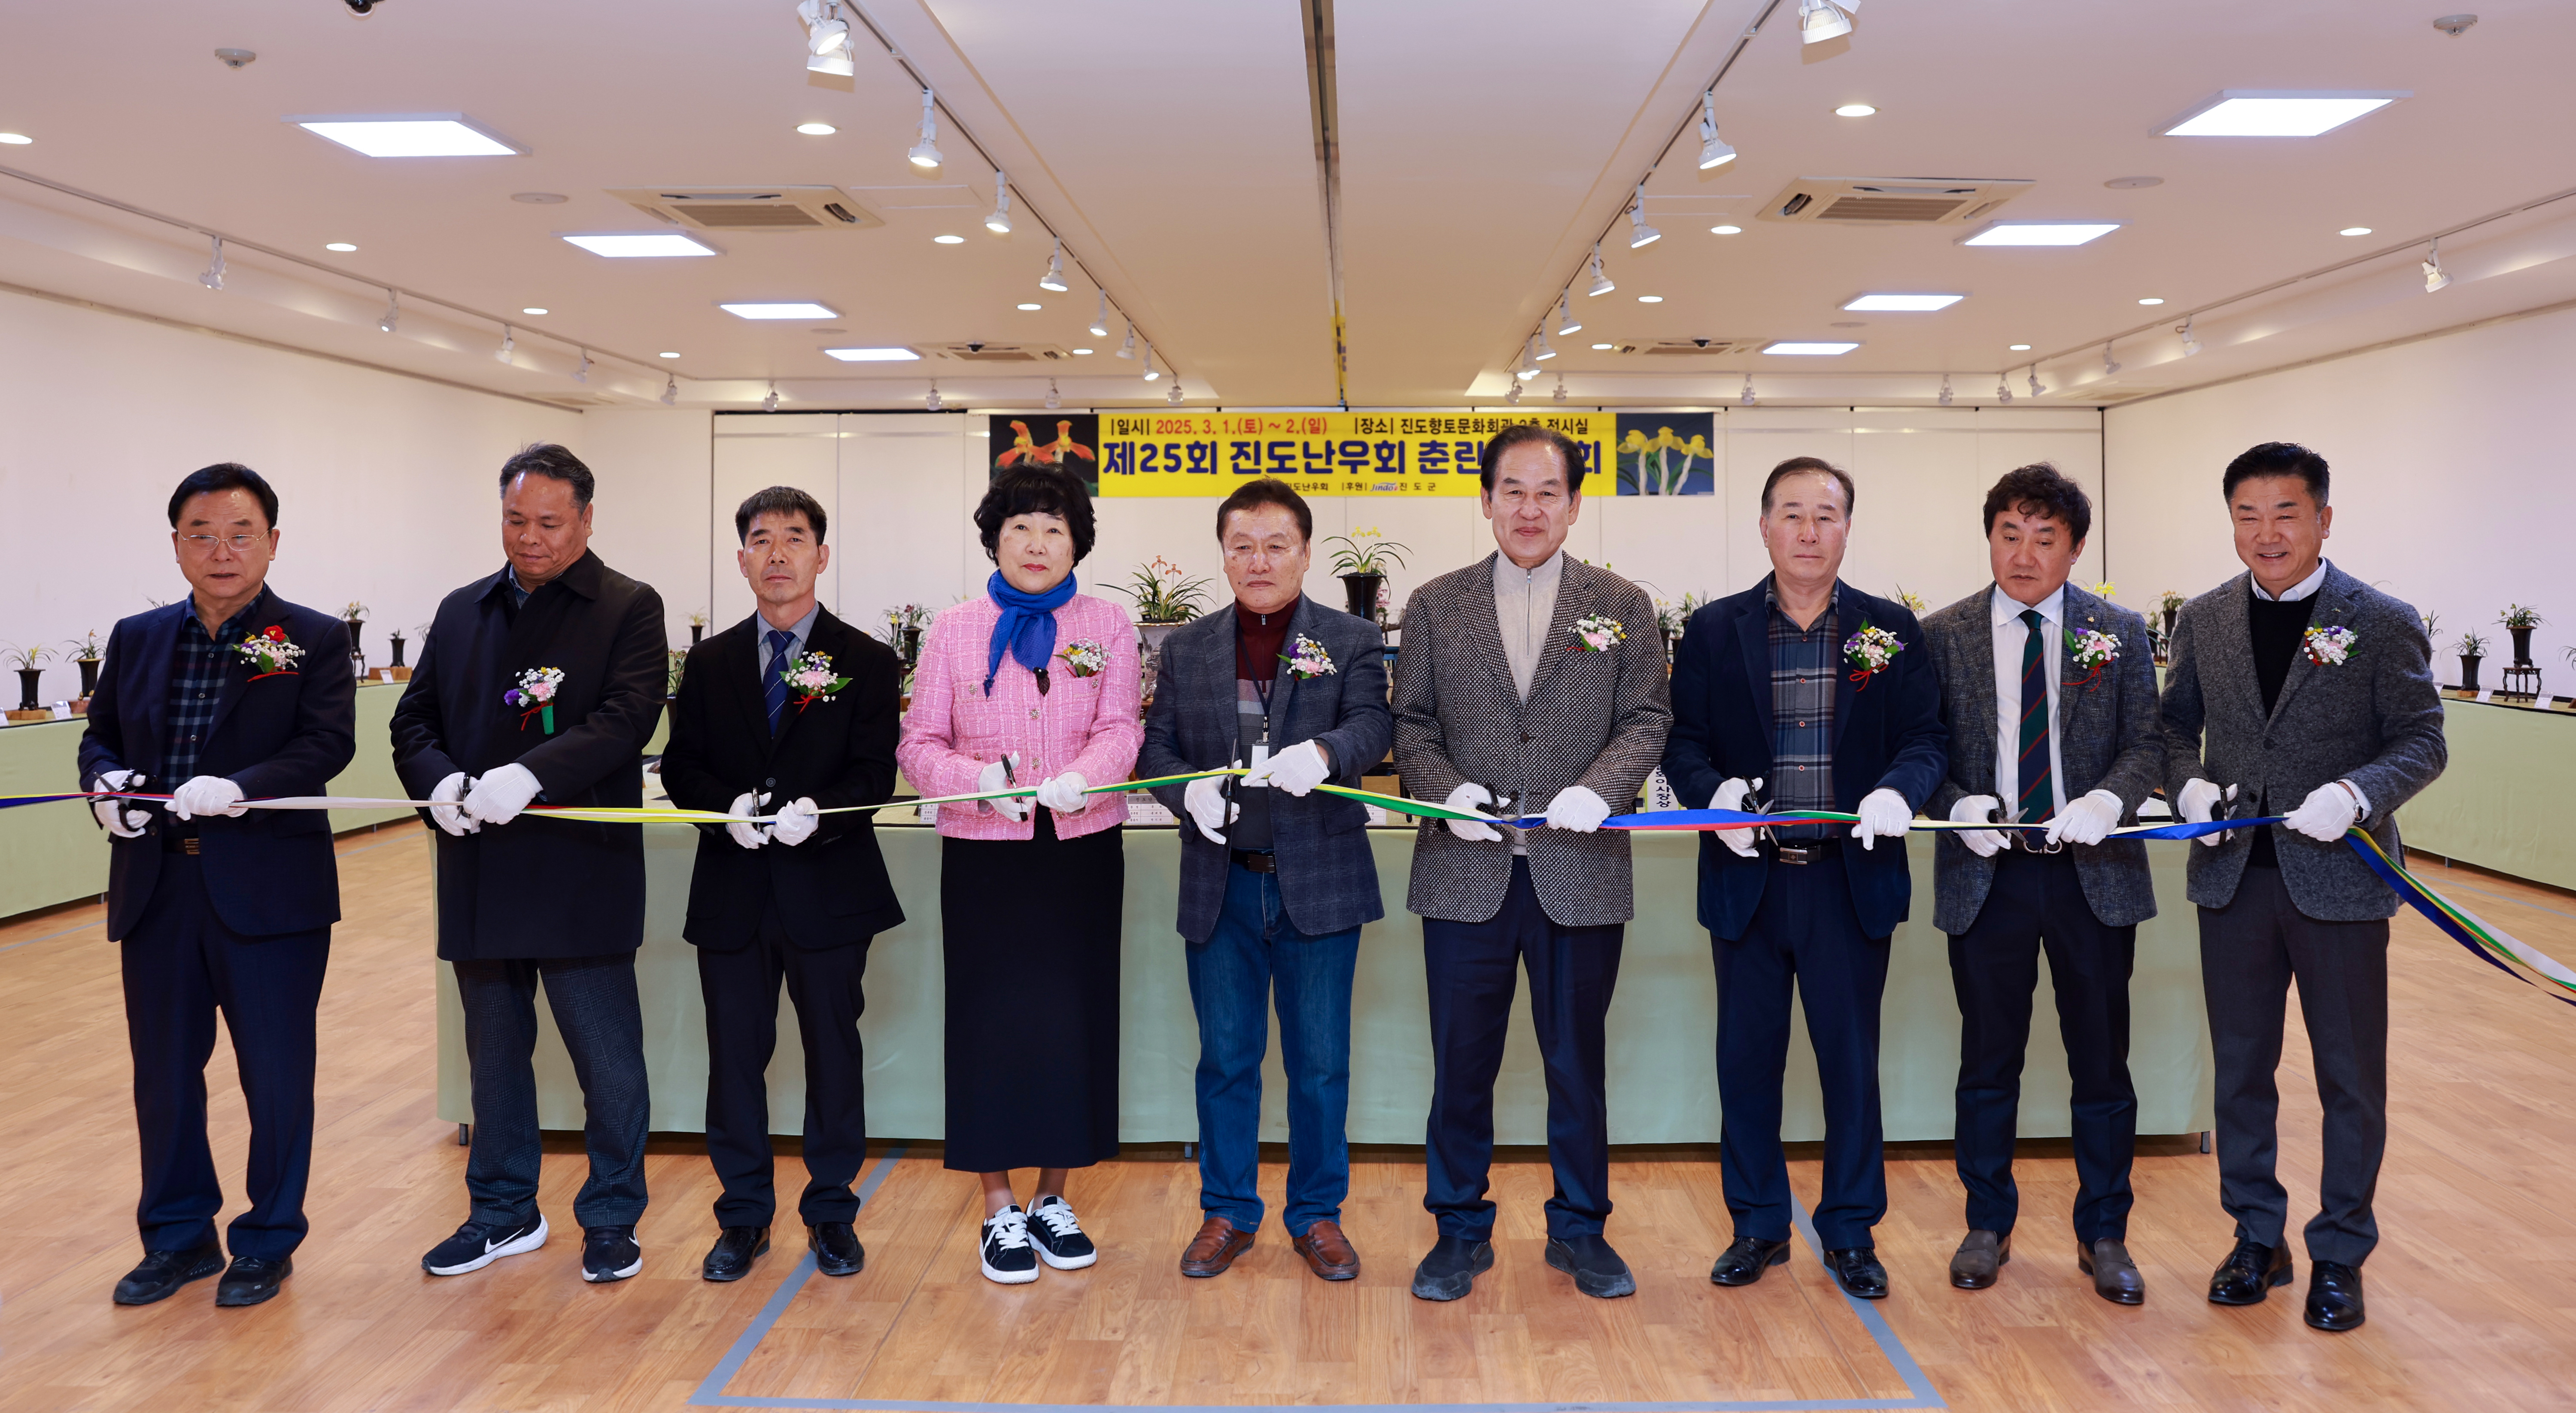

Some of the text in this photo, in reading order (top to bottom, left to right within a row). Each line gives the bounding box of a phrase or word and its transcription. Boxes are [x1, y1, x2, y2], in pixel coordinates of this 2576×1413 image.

[1156, 419, 1197, 435] 2025.
[1203, 419, 1216, 435] 3.
[1286, 418, 1327, 435] 2.(일)
[1103, 440, 1217, 475] 제25회
[1230, 440, 1405, 474] 진도난우회
